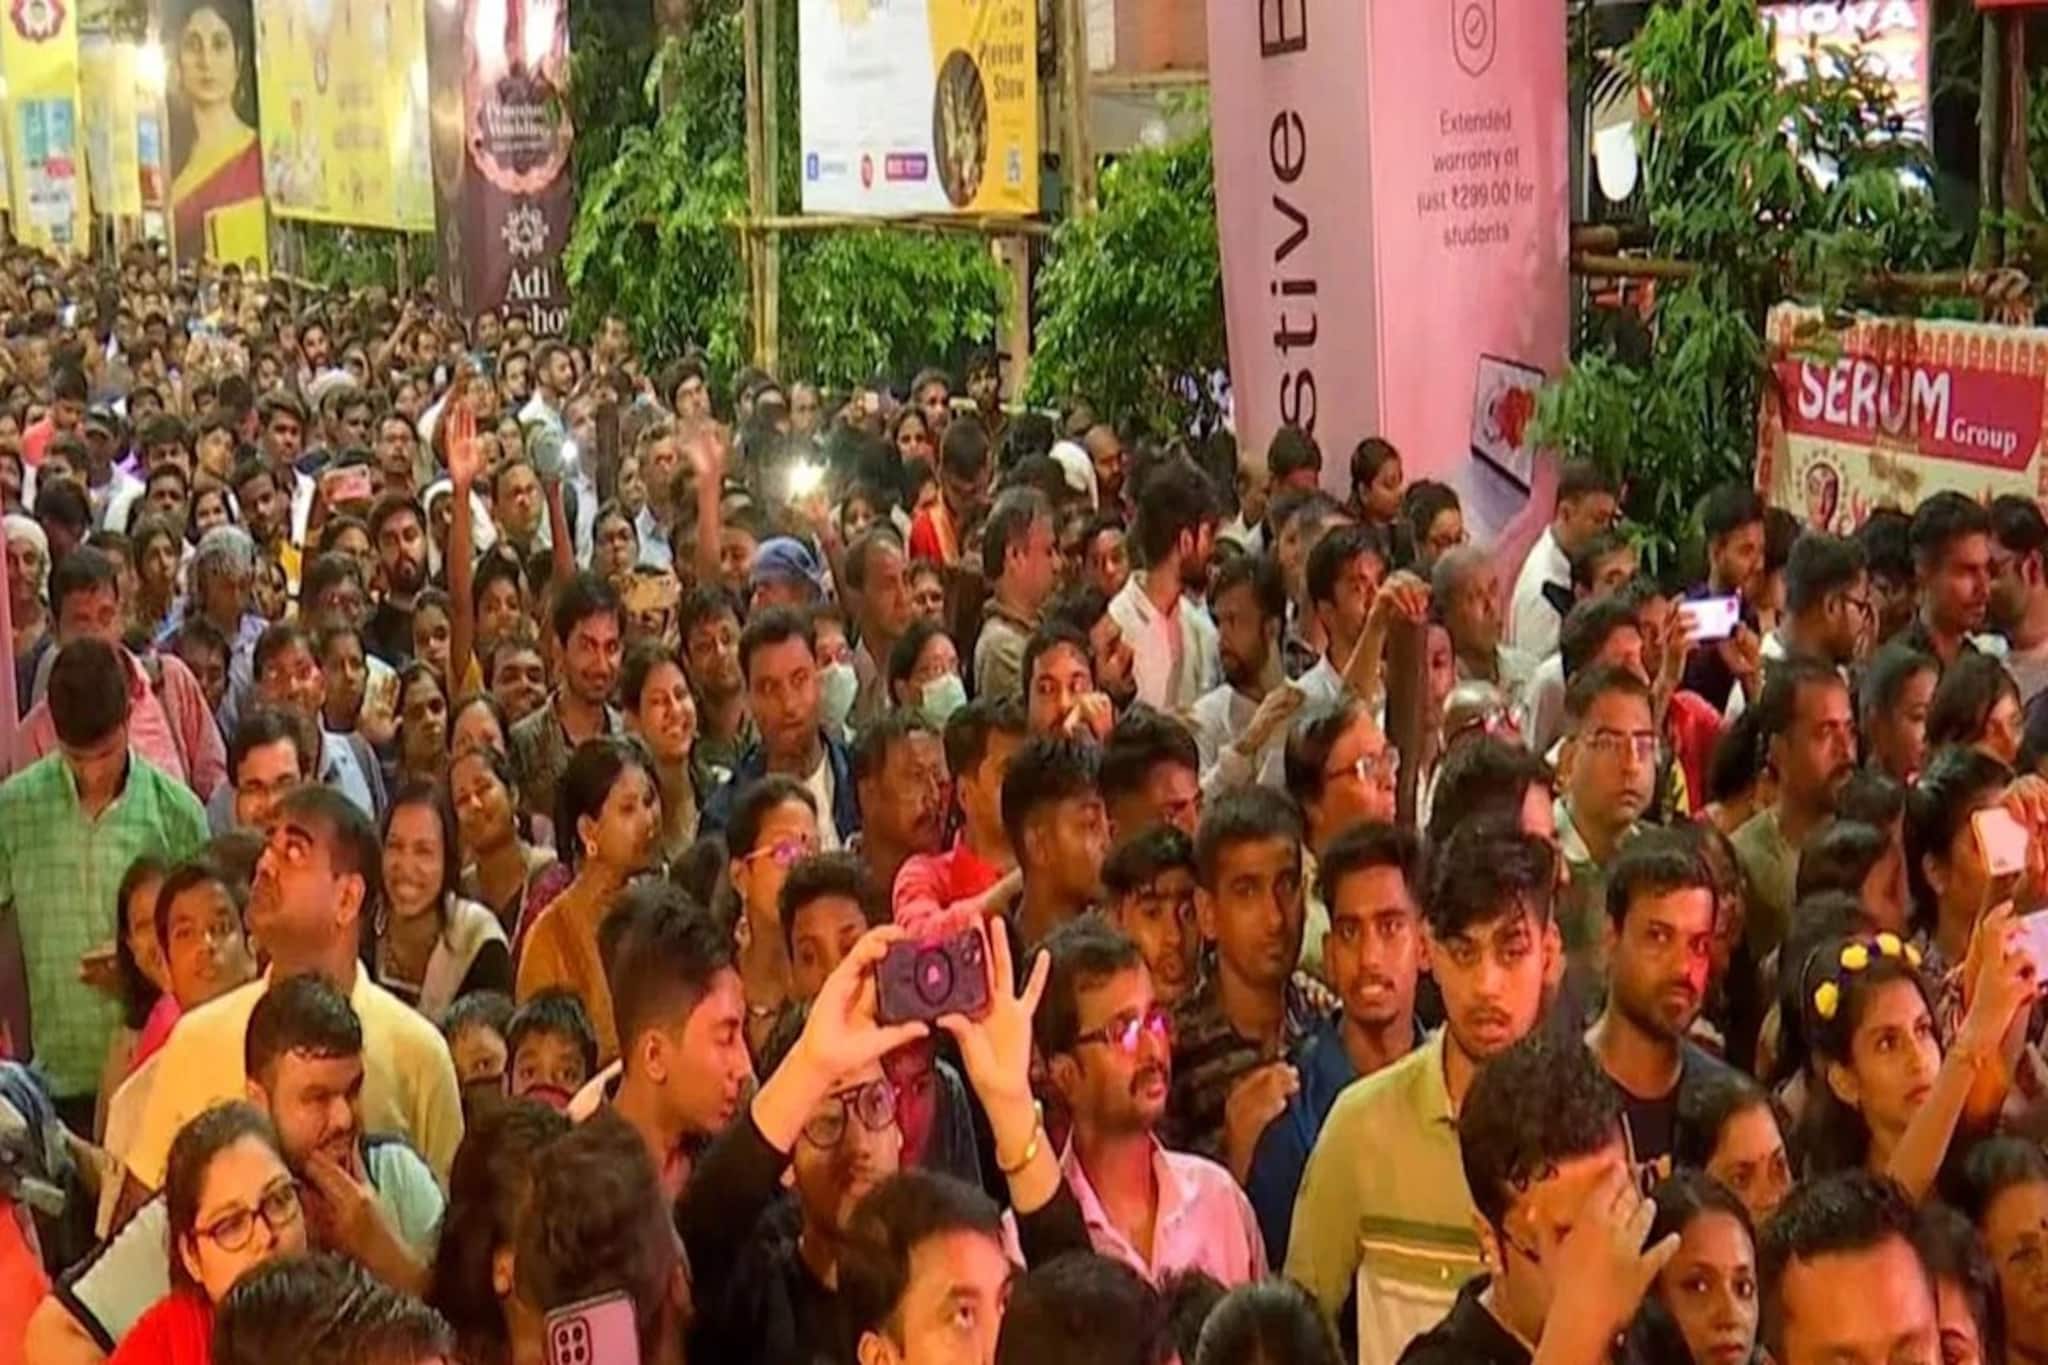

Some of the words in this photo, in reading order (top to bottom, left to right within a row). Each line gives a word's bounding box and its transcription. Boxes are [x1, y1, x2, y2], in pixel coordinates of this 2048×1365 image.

[1439, 108, 1512, 135] Extended
[1432, 149, 1500, 172] warranty
[1503, 147, 1519, 167] at
[1417, 188, 1447, 217] just
[1514, 177, 1535, 204] for
[1443, 219, 1510, 248] students
[1798, 357, 1951, 440] SERUM
[1951, 417, 2018, 456] Group
